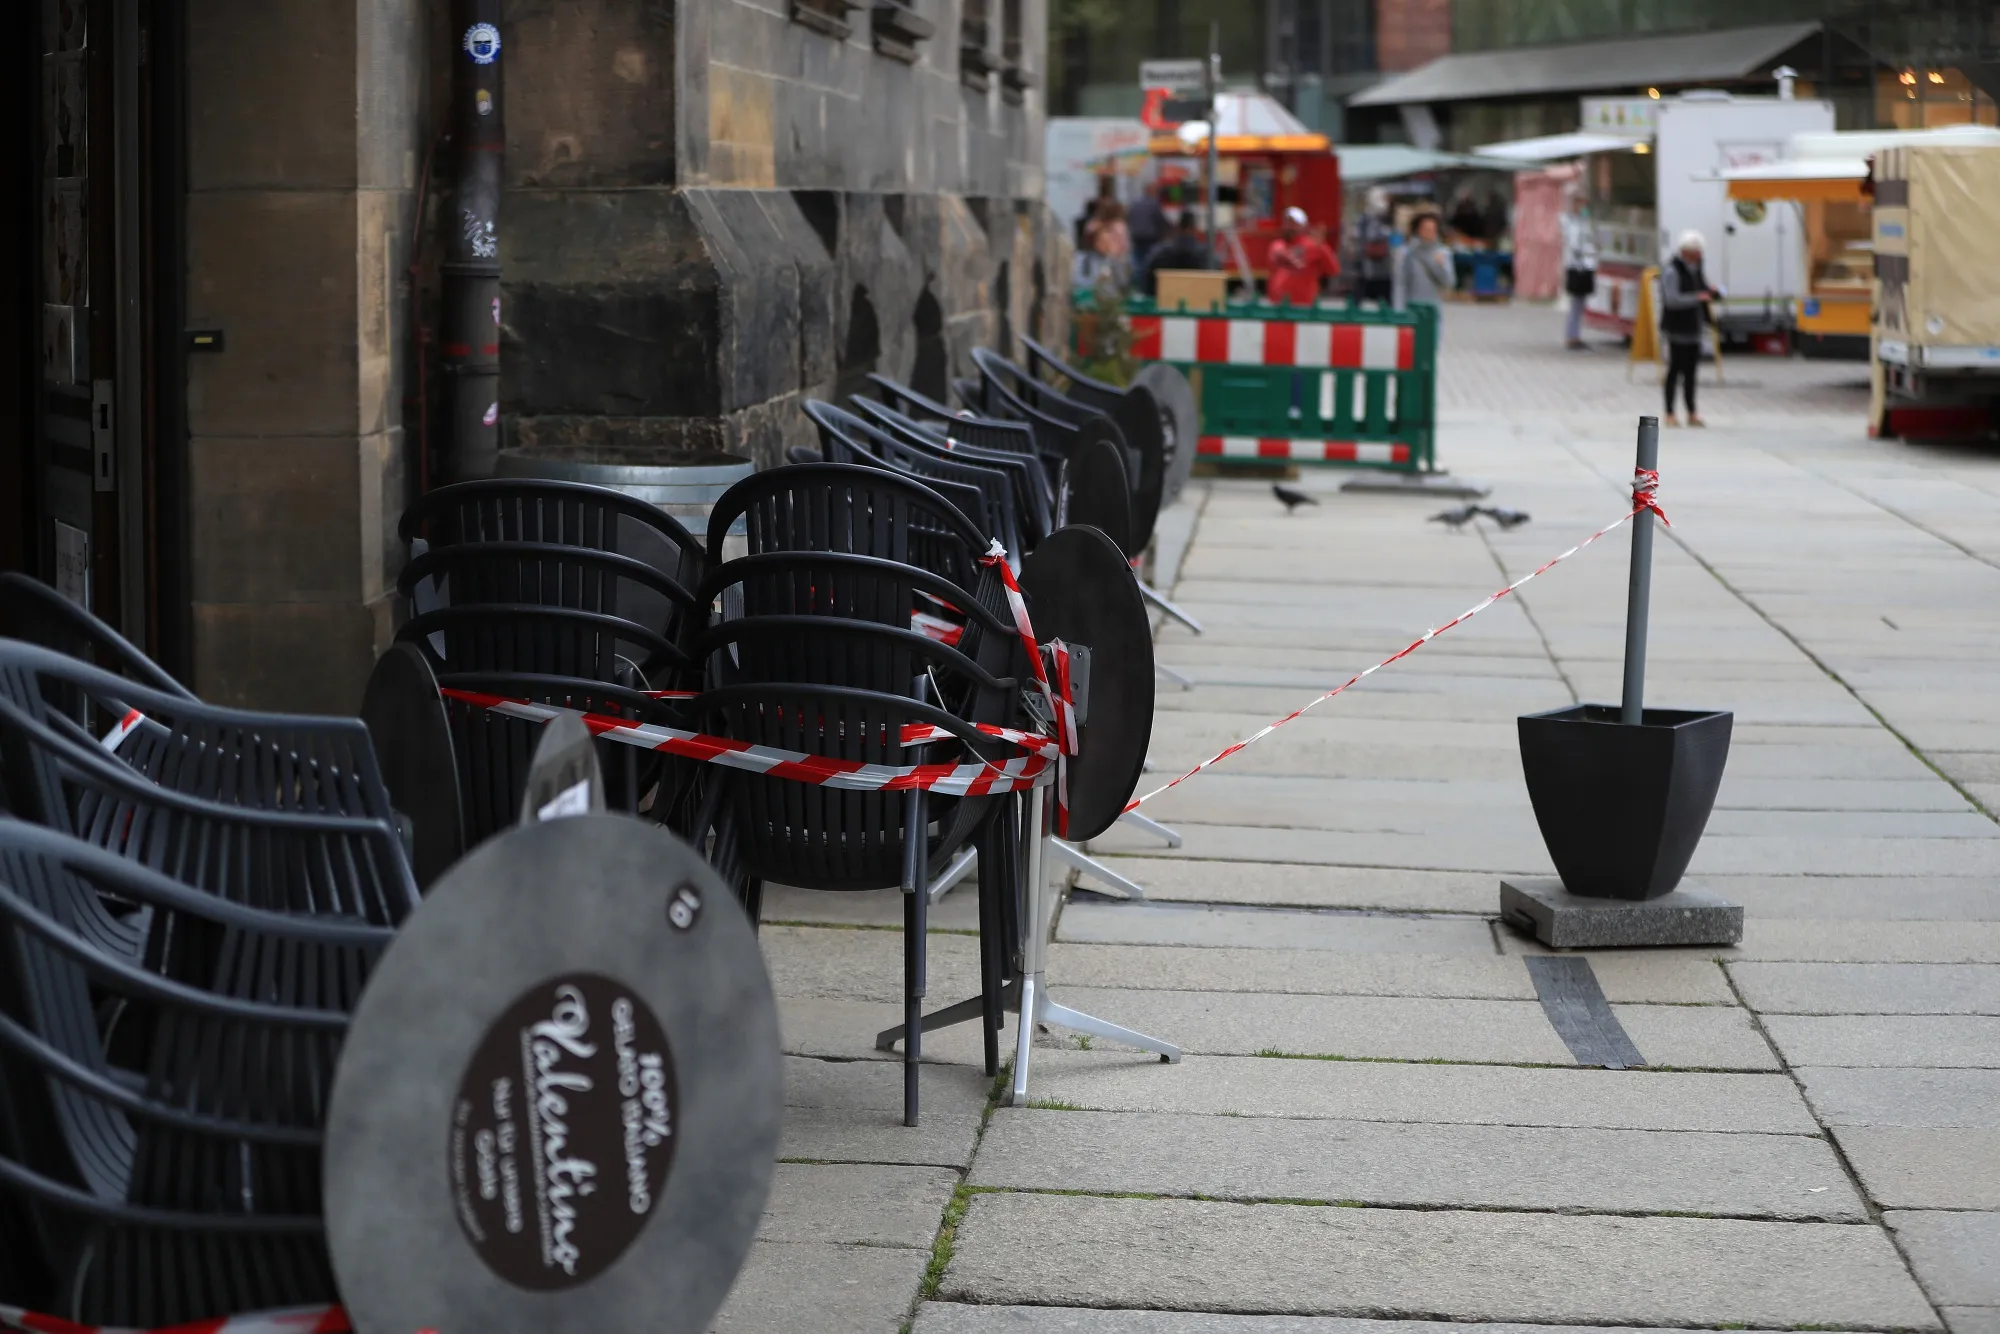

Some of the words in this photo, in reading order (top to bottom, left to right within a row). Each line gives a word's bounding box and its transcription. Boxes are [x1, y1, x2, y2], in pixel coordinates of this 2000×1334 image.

[611, 997, 639, 1097] GELATO
[638, 1053, 671, 1147] 100%
[530, 984, 598, 1276] Valentino
[620, 1098, 651, 1214] ITALIANO
